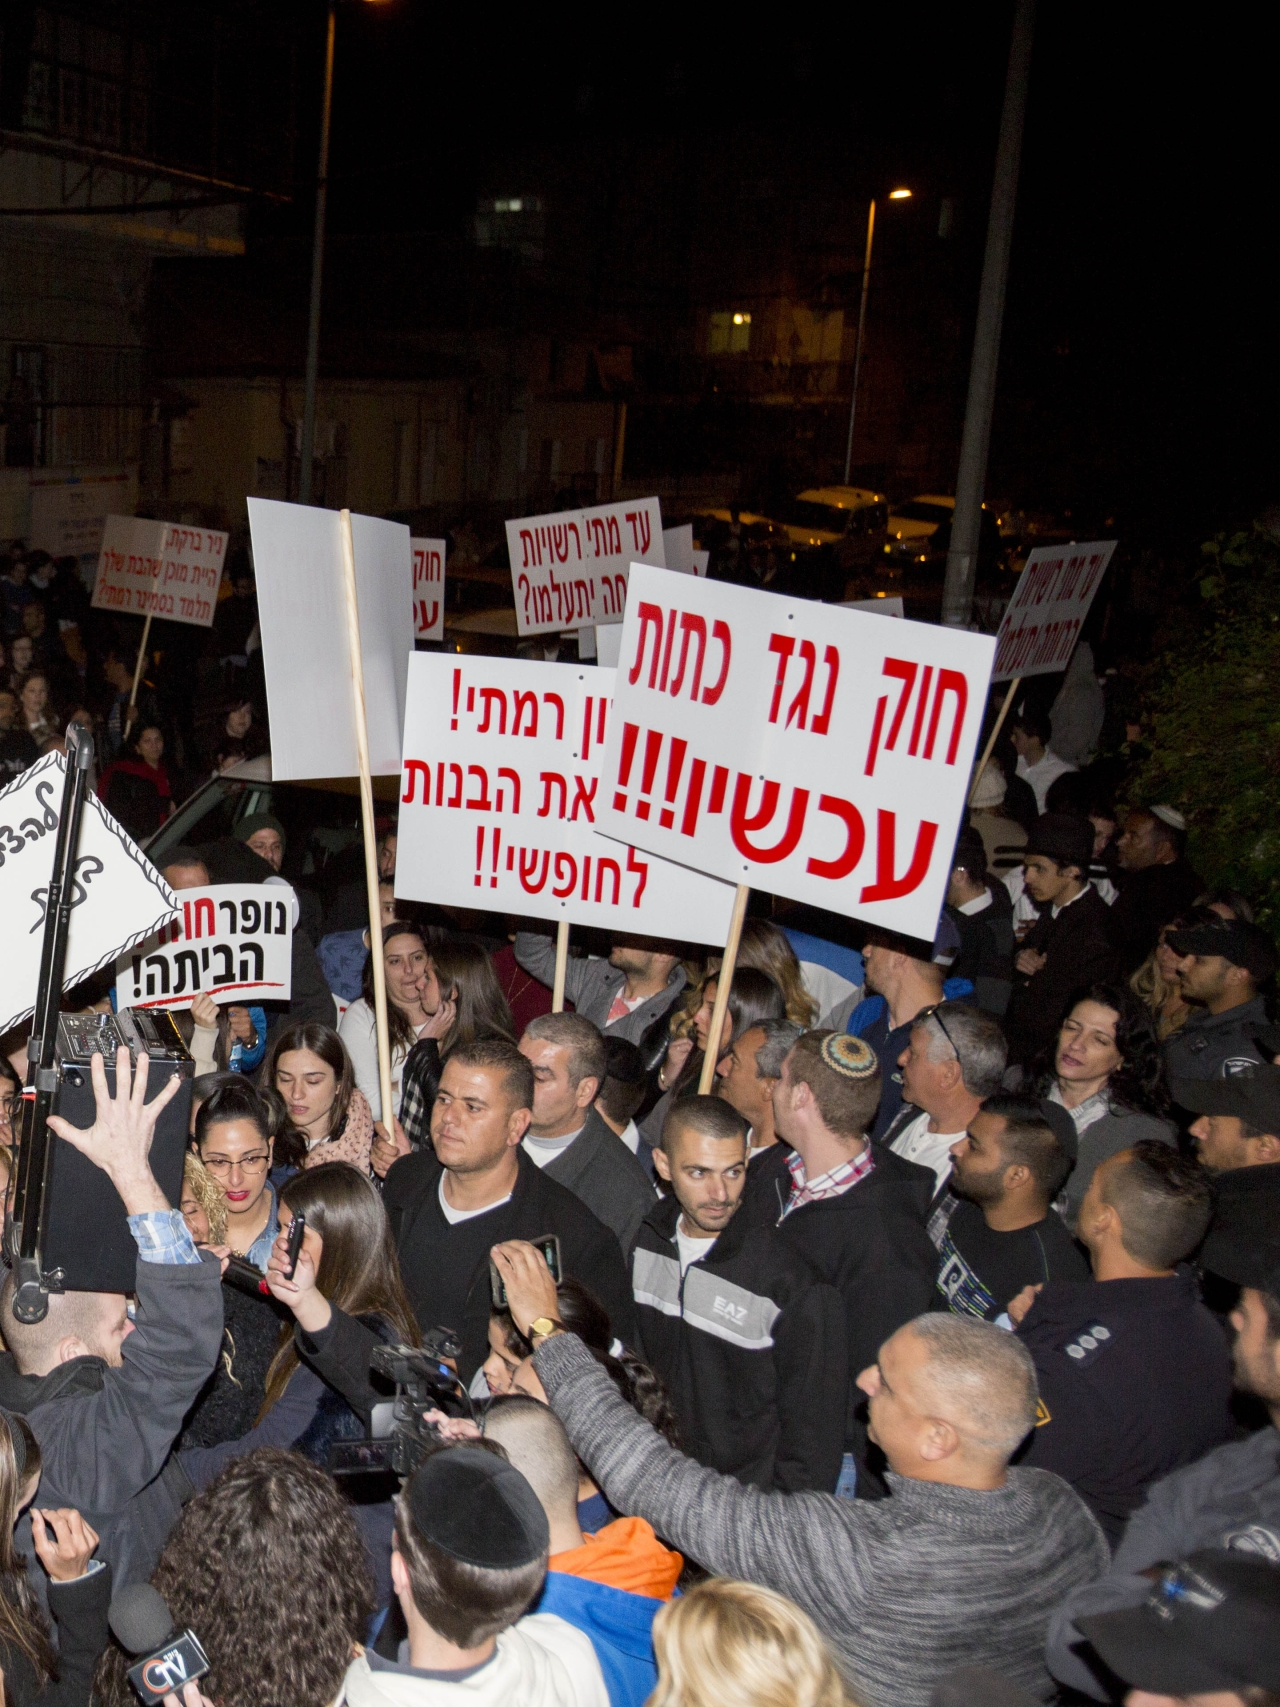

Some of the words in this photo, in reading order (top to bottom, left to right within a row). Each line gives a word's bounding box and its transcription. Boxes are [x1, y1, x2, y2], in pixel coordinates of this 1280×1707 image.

[519, 522, 582, 568] רשויות
[586, 515, 622, 558] מתי
[626, 510, 651, 555] עד
[413, 550, 441, 590] חוק
[518, 569, 595, 625] יתעלמו?
[628, 601, 732, 706] כתות
[450, 668, 565, 740] רמתי!
[768, 632, 840, 736] נגד
[864, 656, 969, 778] חוק
[401, 759, 521, 814] הבנות
[612, 721, 939, 904] עכשיו!!!
[473, 825, 649, 909] לחופשי!!
[219, 900, 287, 936] נופר
[132, 943, 265, 998] הביתה!
[713, 1296, 748, 1318] EA7
